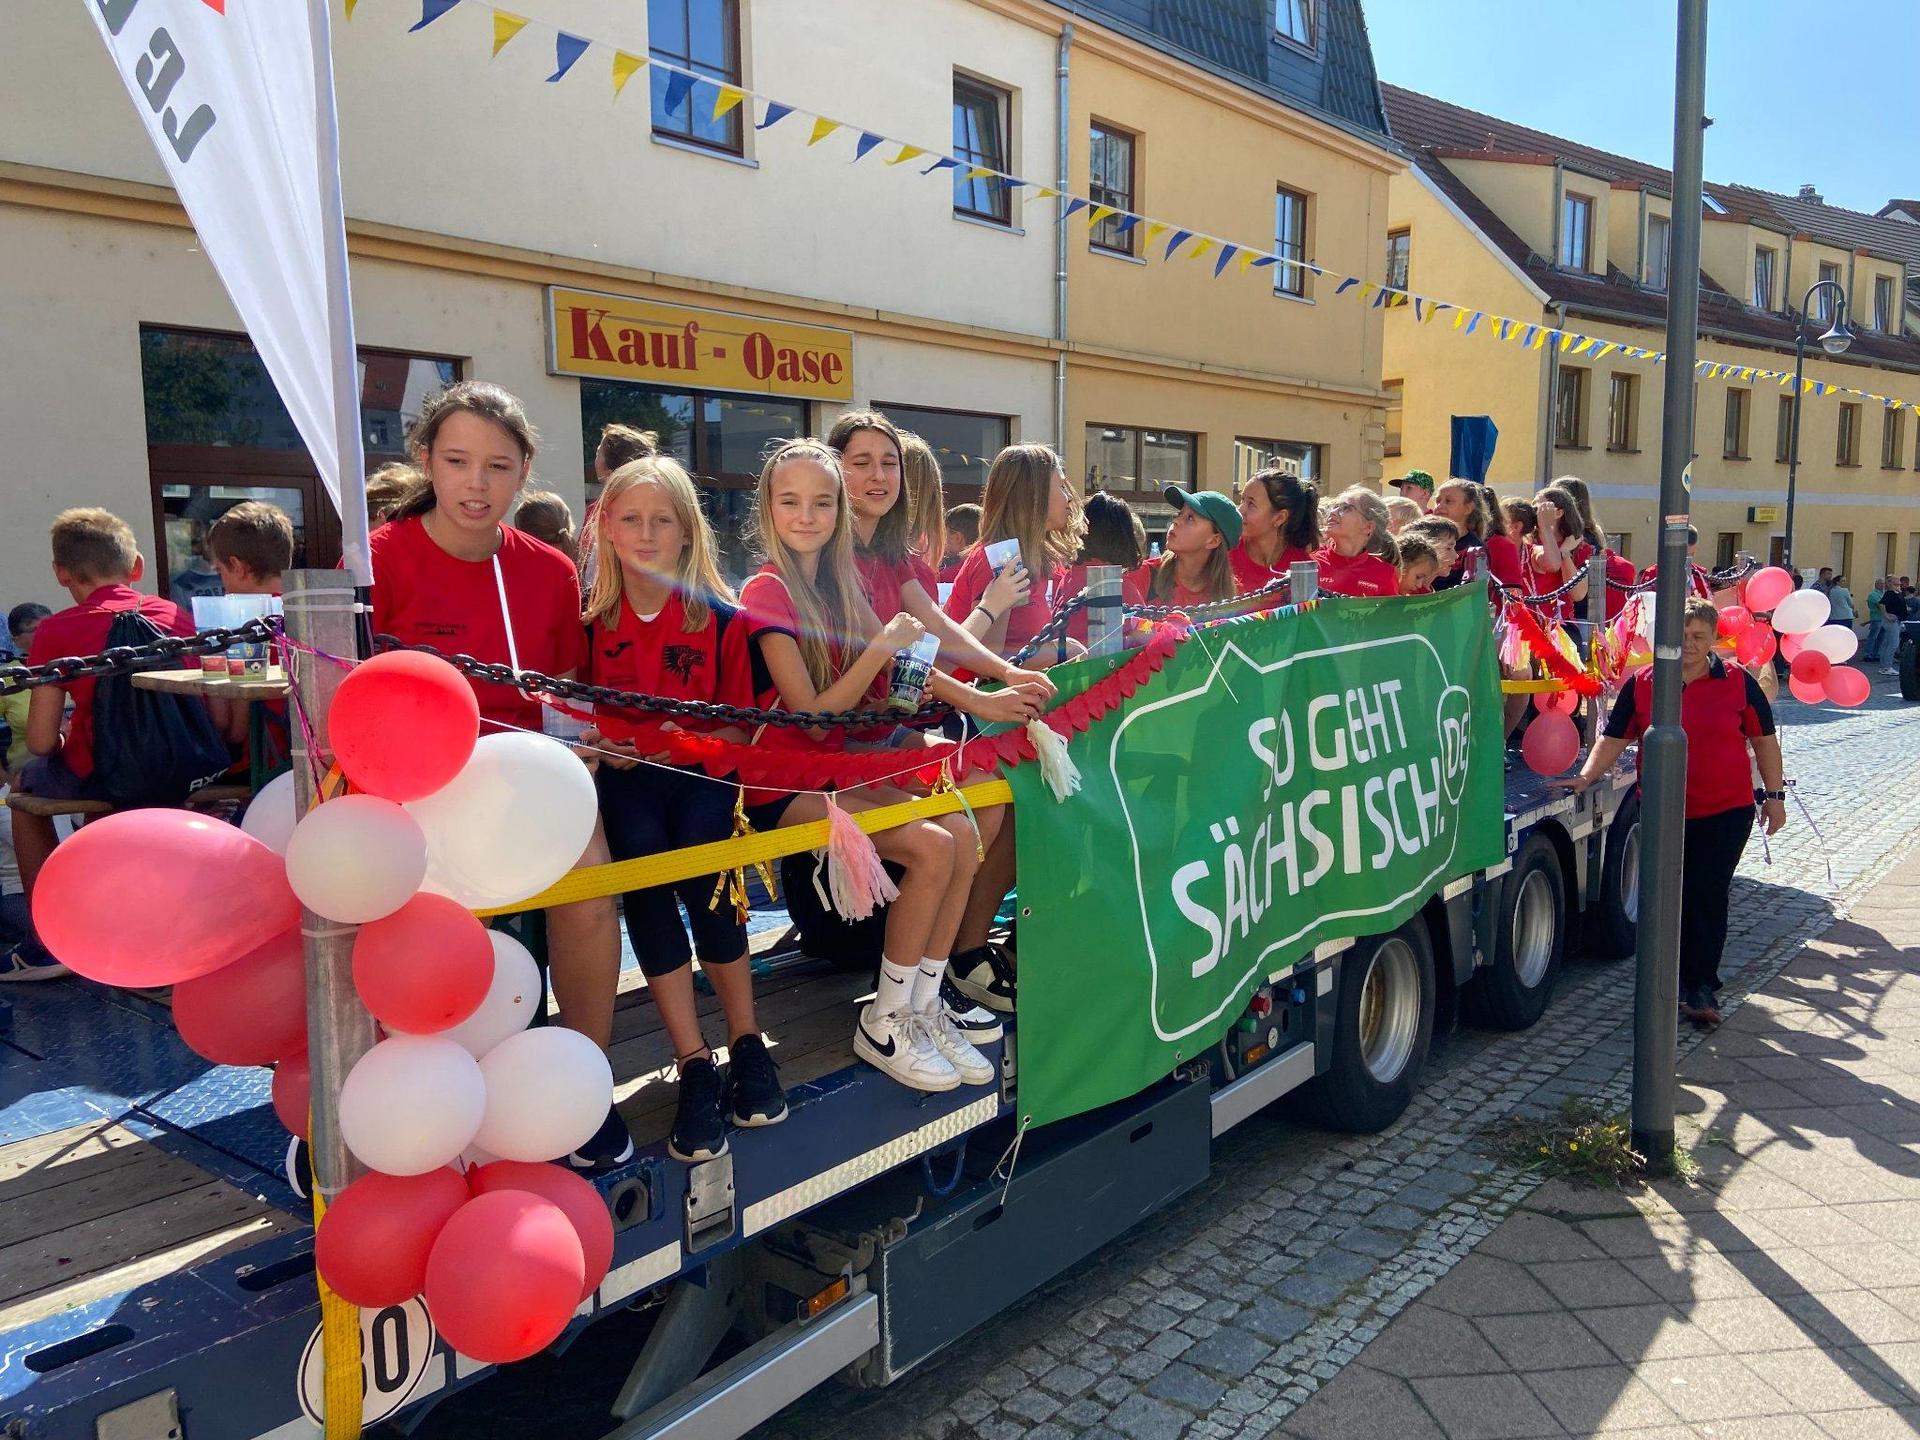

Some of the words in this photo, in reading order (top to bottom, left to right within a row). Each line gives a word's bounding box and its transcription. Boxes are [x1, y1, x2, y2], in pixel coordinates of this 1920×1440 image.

[568, 306, 699, 371] Kauf
[712, 346, 727, 359] -
[742, 331, 844, 385] Oase
[1248, 707, 1295, 802] SO
[1308, 679, 1407, 771] GEHT
[1443, 711, 1469, 779] DE
[1171, 757, 1445, 978] SÄCHSISCH.
[359, 1304, 411, 1400] 0
